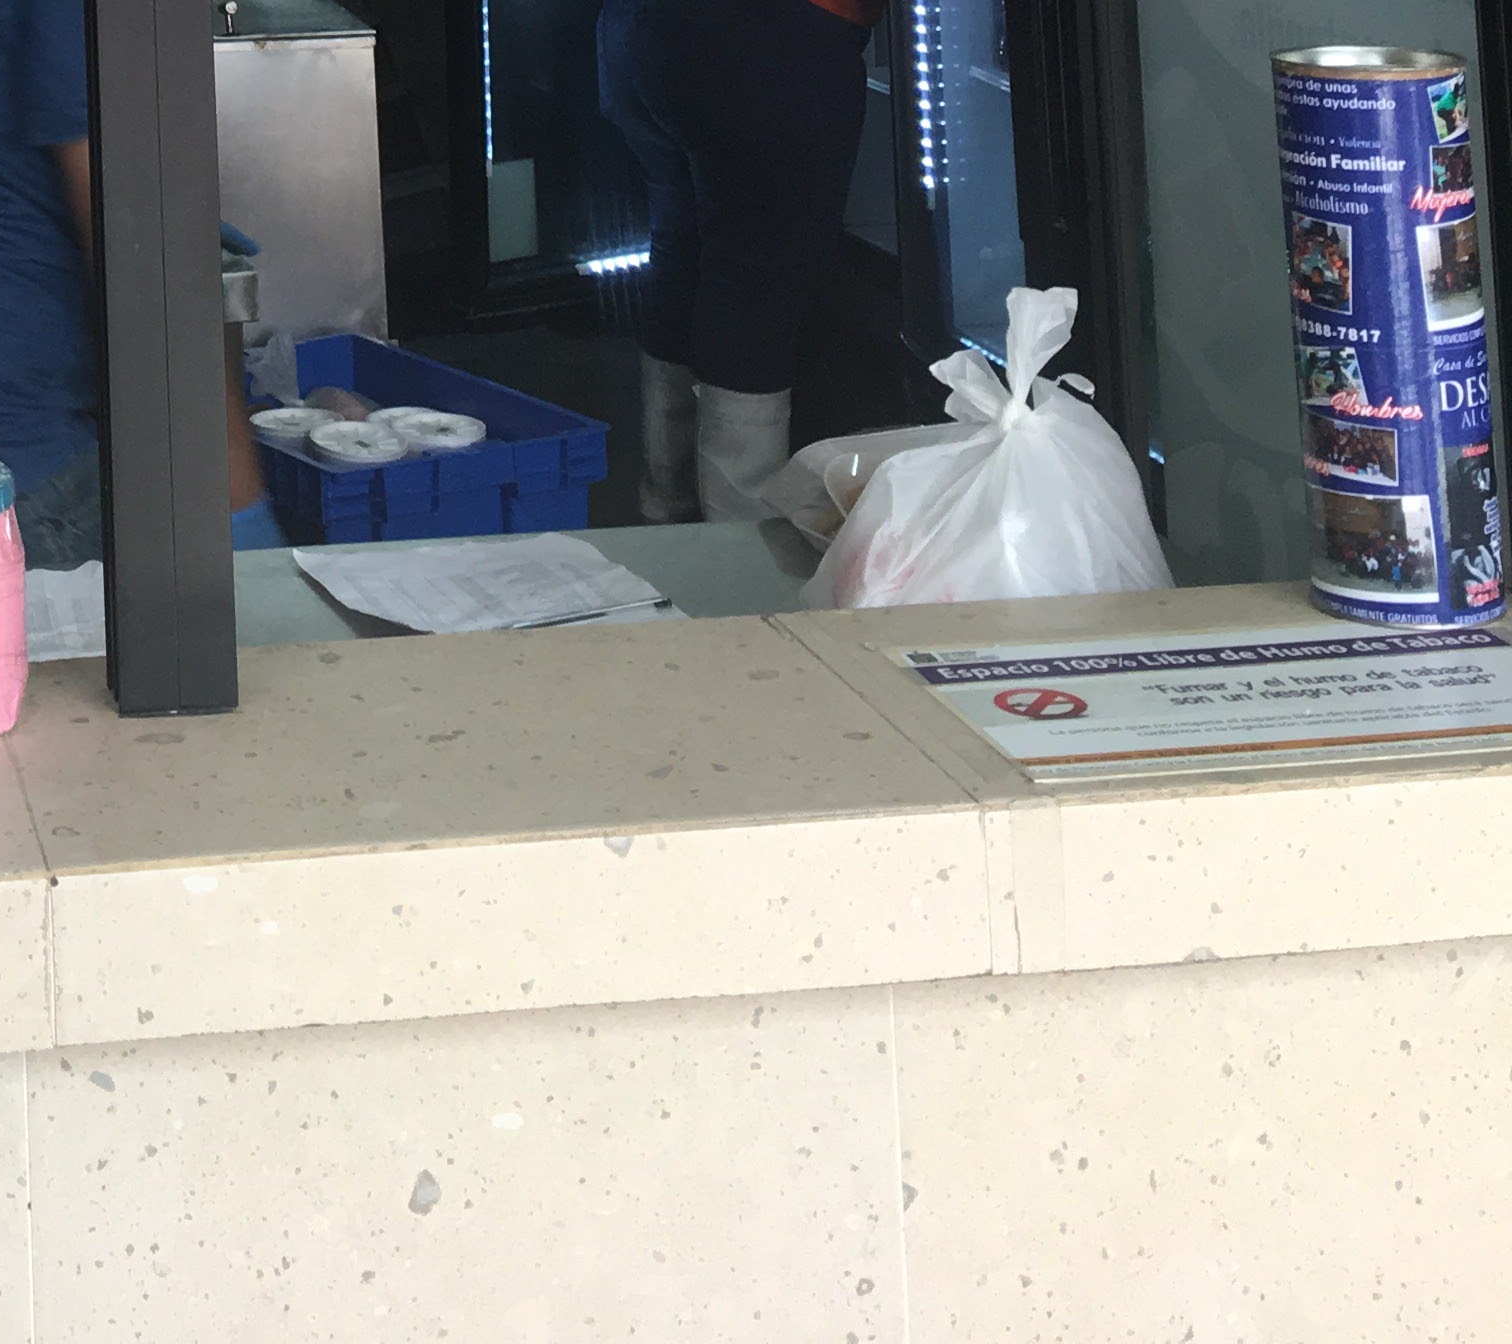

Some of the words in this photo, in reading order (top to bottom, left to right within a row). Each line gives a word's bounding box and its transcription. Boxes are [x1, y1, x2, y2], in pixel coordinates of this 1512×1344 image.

[1305, 79, 1322, 92] de
[1324, 82, 1358, 94] unas
[1322, 97, 1396, 110] ayudando
[1330, 153, 1407, 172] Familiar
[1317, 179, 1351, 192] Abuso
[1353, 182, 1393, 194] Infantil
[1295, 190, 1369, 215] Alcoholismo
[935, 661, 1052, 679] Espacio
[1135, 650, 1217, 666] Libre
[1215, 646, 1256, 660] de
[1256, 643, 1349, 658] Humo
[1347, 638, 1390, 651] de
[1387, 631, 1493, 648] Tabaco
[1235, 680, 1258, 690] y
[1259, 676, 1287, 687] el
[1289, 671, 1358, 684] humo
[1361, 668, 1397, 679] de
[1399, 662, 1484, 677] tabaco
[1167, 694, 1216, 706] son
[1218, 692, 1255, 702] un
[1256, 685, 1335, 702] riesgo
[1337, 682, 1396, 696] para
[1395, 679, 1422, 689] la
